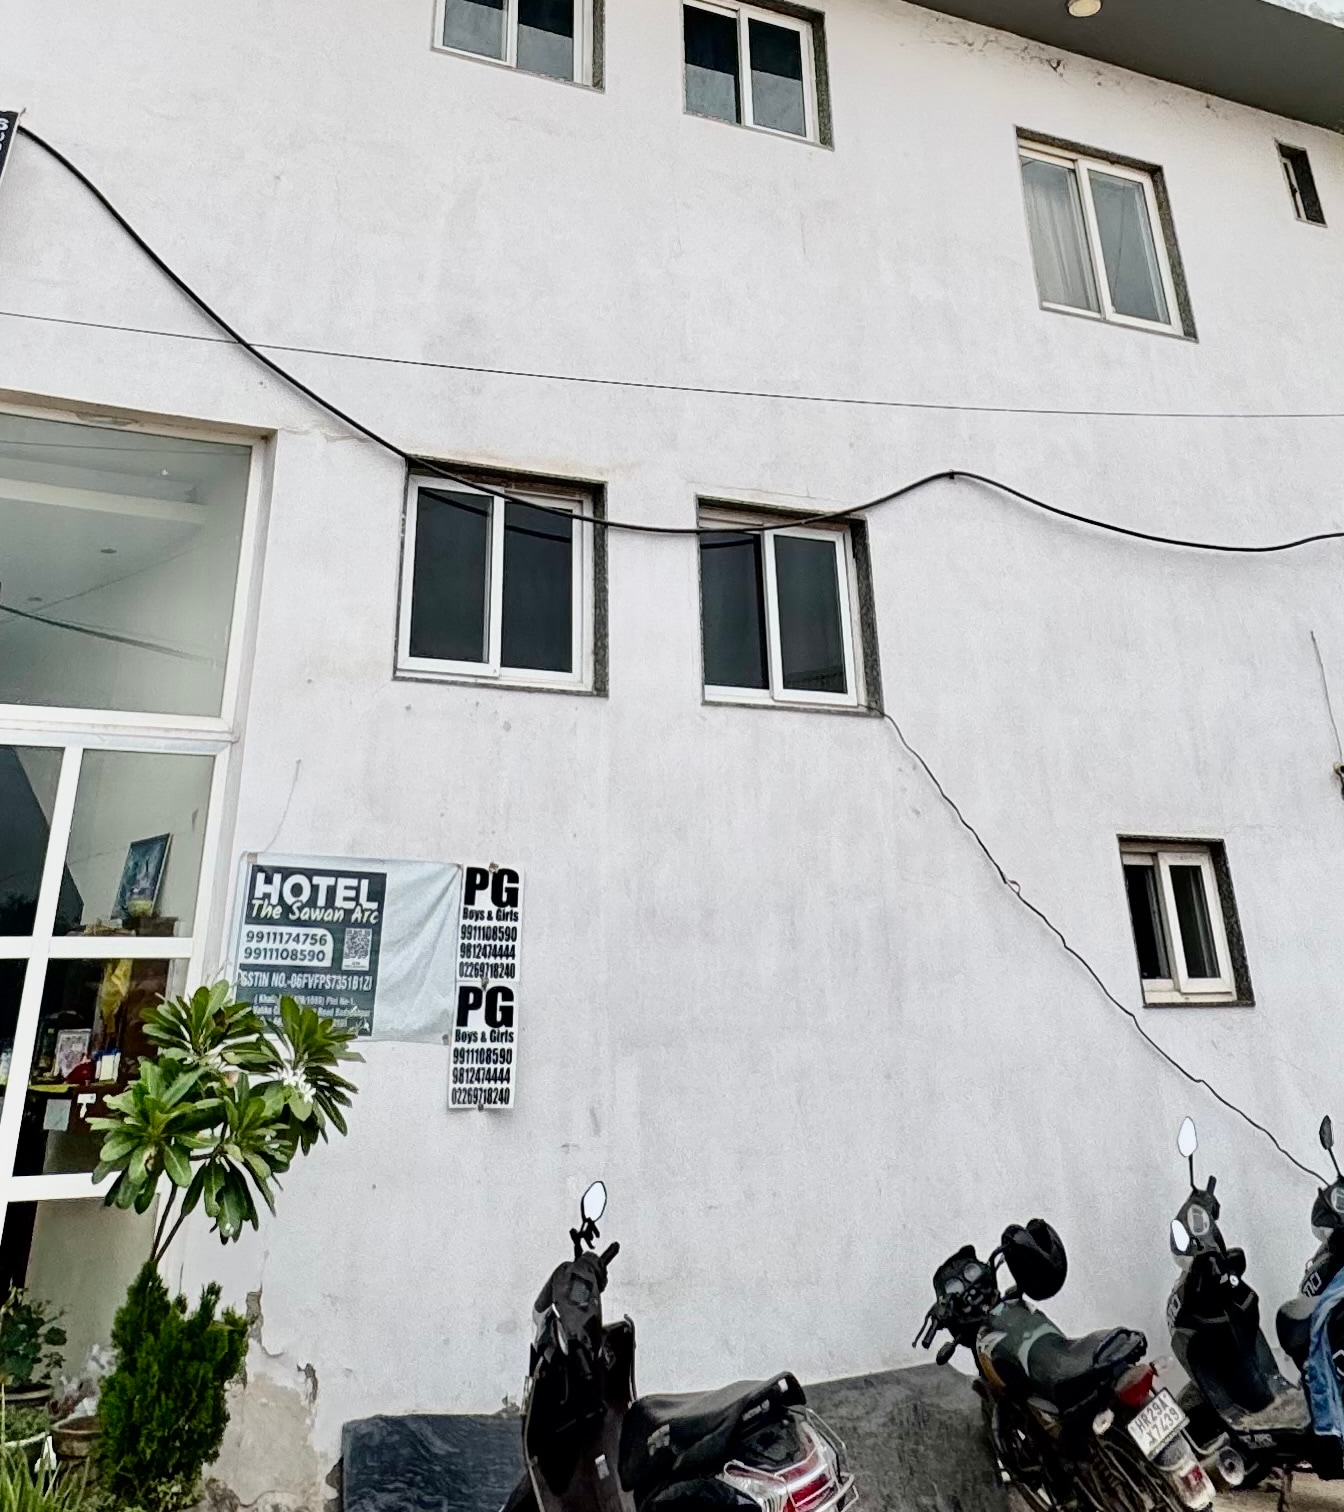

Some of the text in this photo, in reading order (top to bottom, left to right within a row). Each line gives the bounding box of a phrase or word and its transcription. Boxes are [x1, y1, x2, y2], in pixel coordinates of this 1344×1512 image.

[253, 871, 379, 909] HOTEL
[463, 866, 520, 908] PG
[251, 898, 380, 924] The Sawan Arc
[462, 907, 519, 923] Boys & Girls
[246, 930, 328, 947] 9911174756
[460, 924, 517, 942] 9911108590
[244, 947, 326, 963] 9911108590
[459, 943, 516, 960] 9812474444
[459, 961, 515, 979] 02269718240
[457, 985, 514, 1028] PG
[455, 1029, 514, 1045] Boys & Girls
[453, 1048, 513, 1066] 9911108590
[452, 1067, 511, 1085] 9812474444
[451, 1087, 510, 1106] 02269718240
